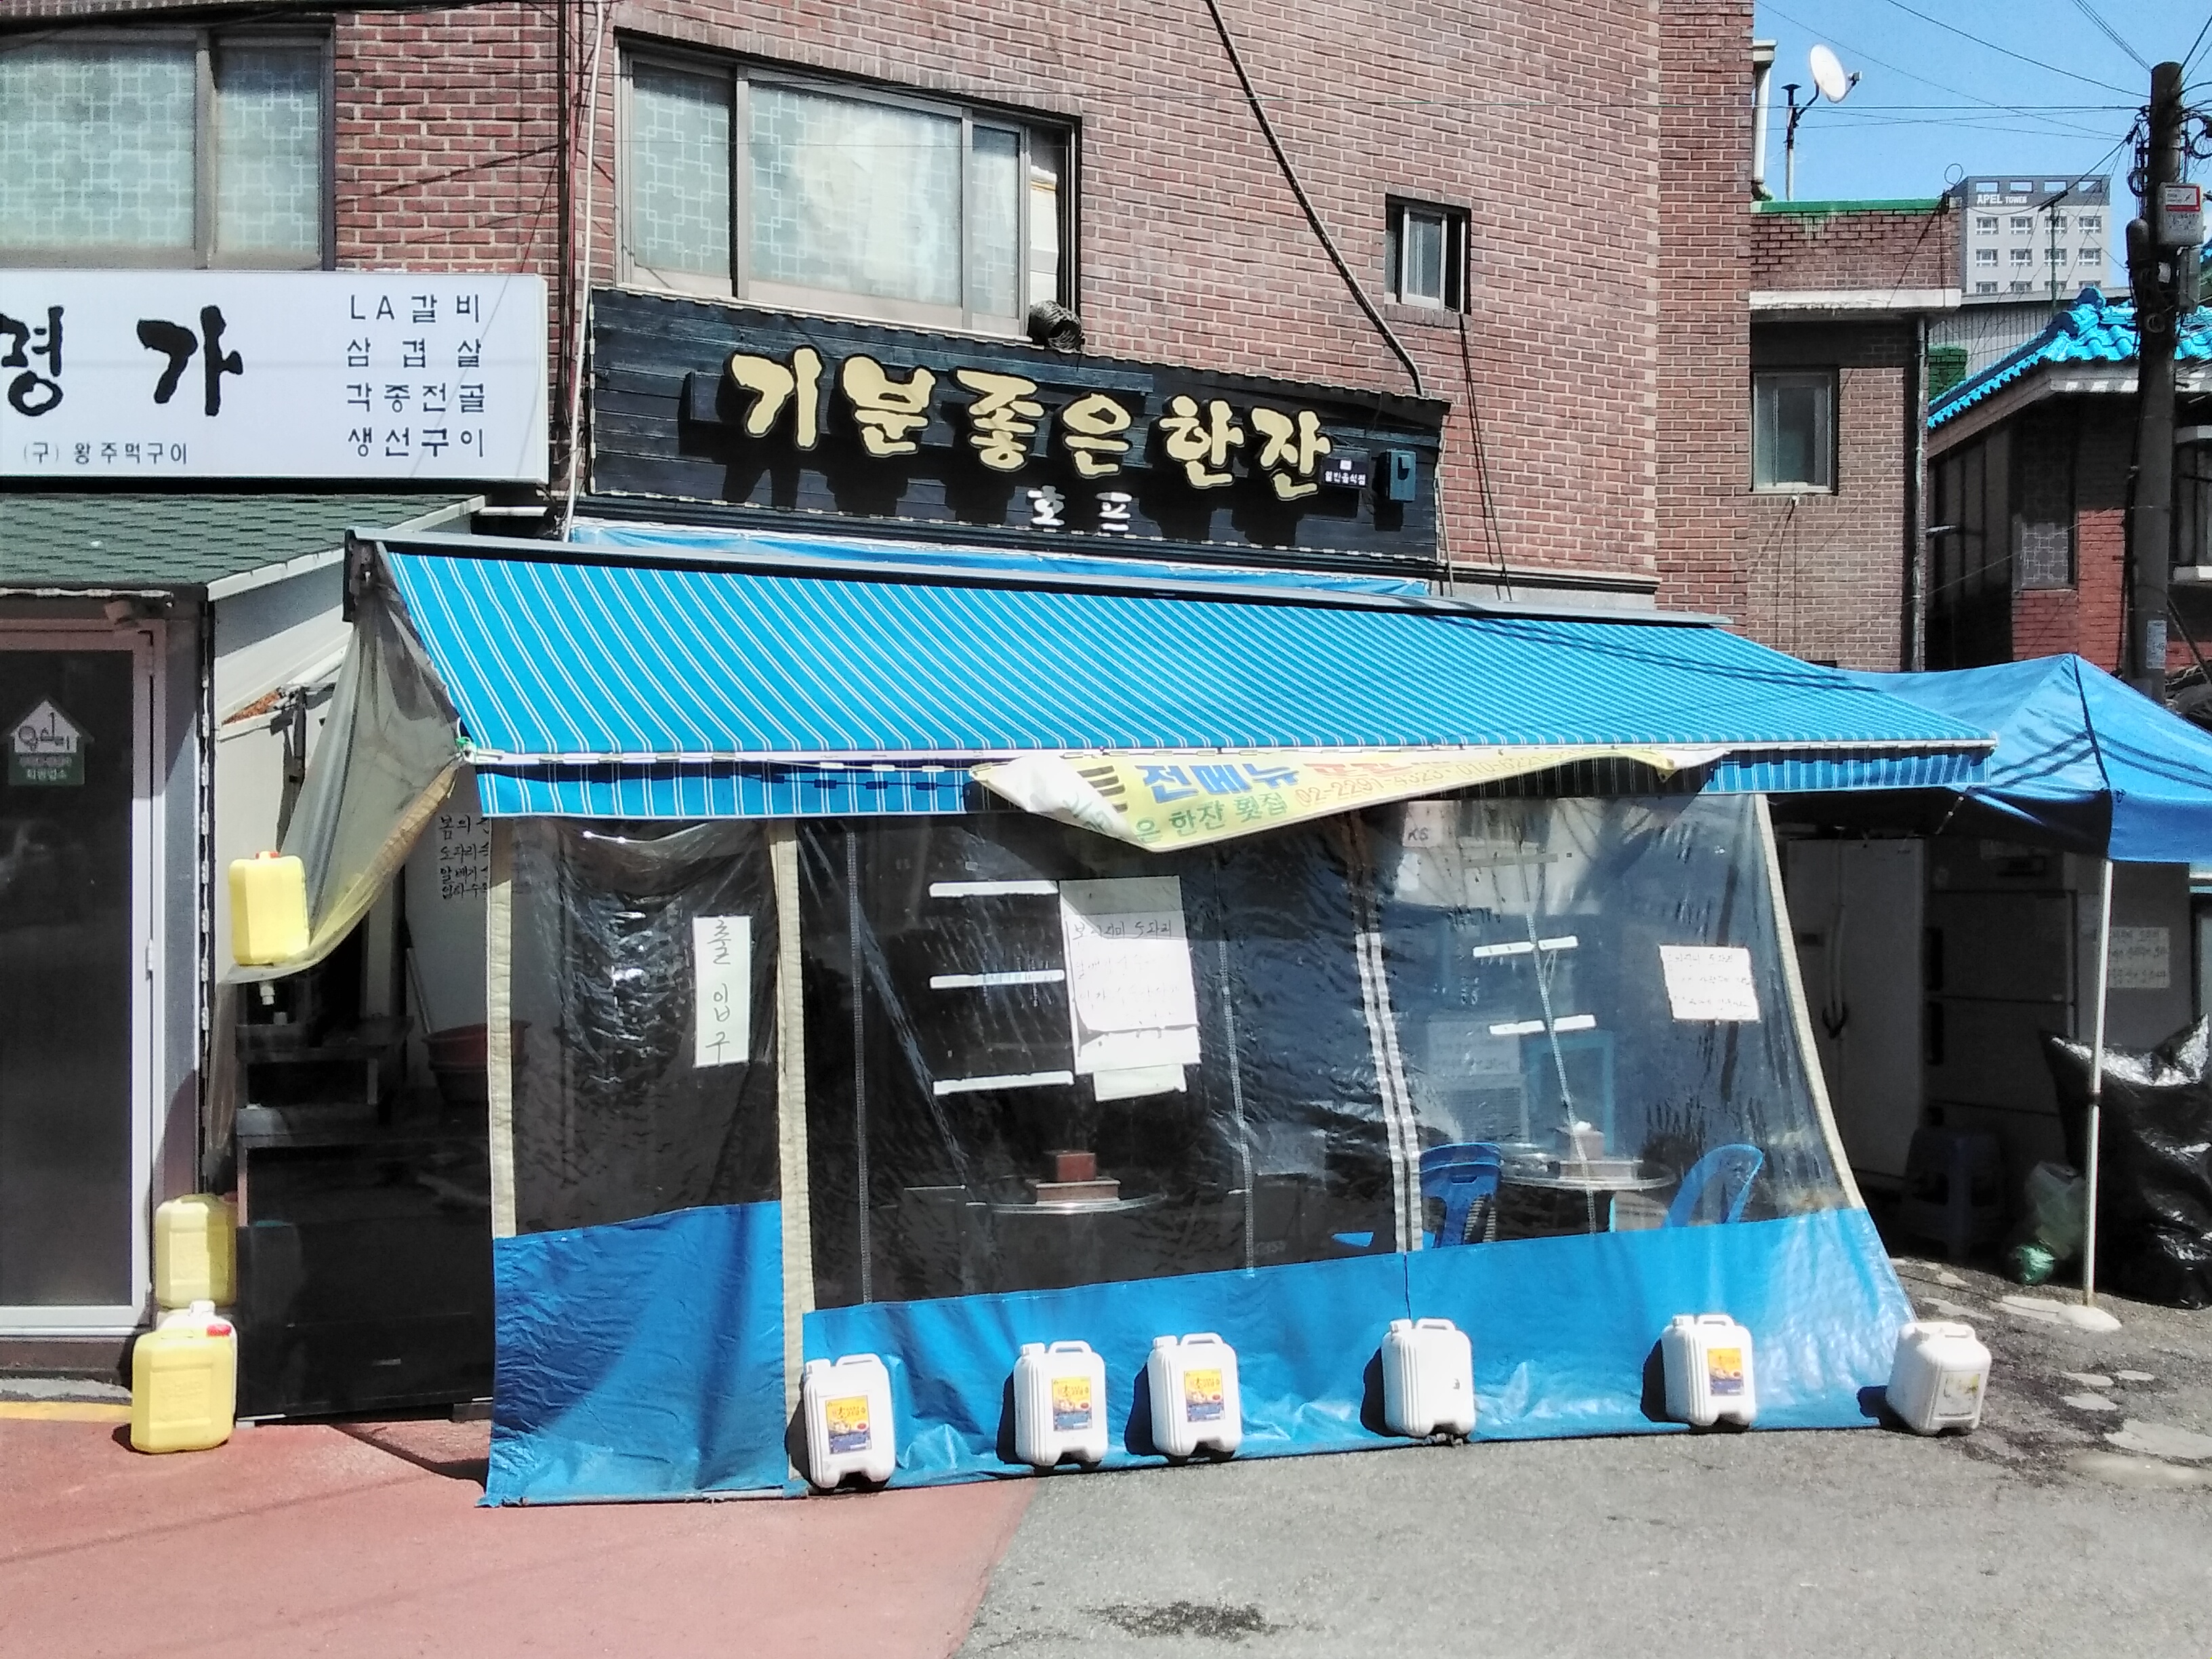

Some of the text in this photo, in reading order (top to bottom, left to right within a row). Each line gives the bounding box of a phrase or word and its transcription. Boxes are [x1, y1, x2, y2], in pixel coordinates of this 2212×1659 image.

[1977, 194, 2028, 204] APEL TOWER
[347, 337, 482, 368] 삼겹살
[346, 382, 485, 413] 각종전골
[74, 443, 188, 465] 왕주먹구이
[348, 426, 485, 457] 생선구이
[1159, 395, 1332, 499] 한잔
[1325, 470, 1366, 486] 일반음식점
[1134, 763, 1300, 804] 전메뉴
